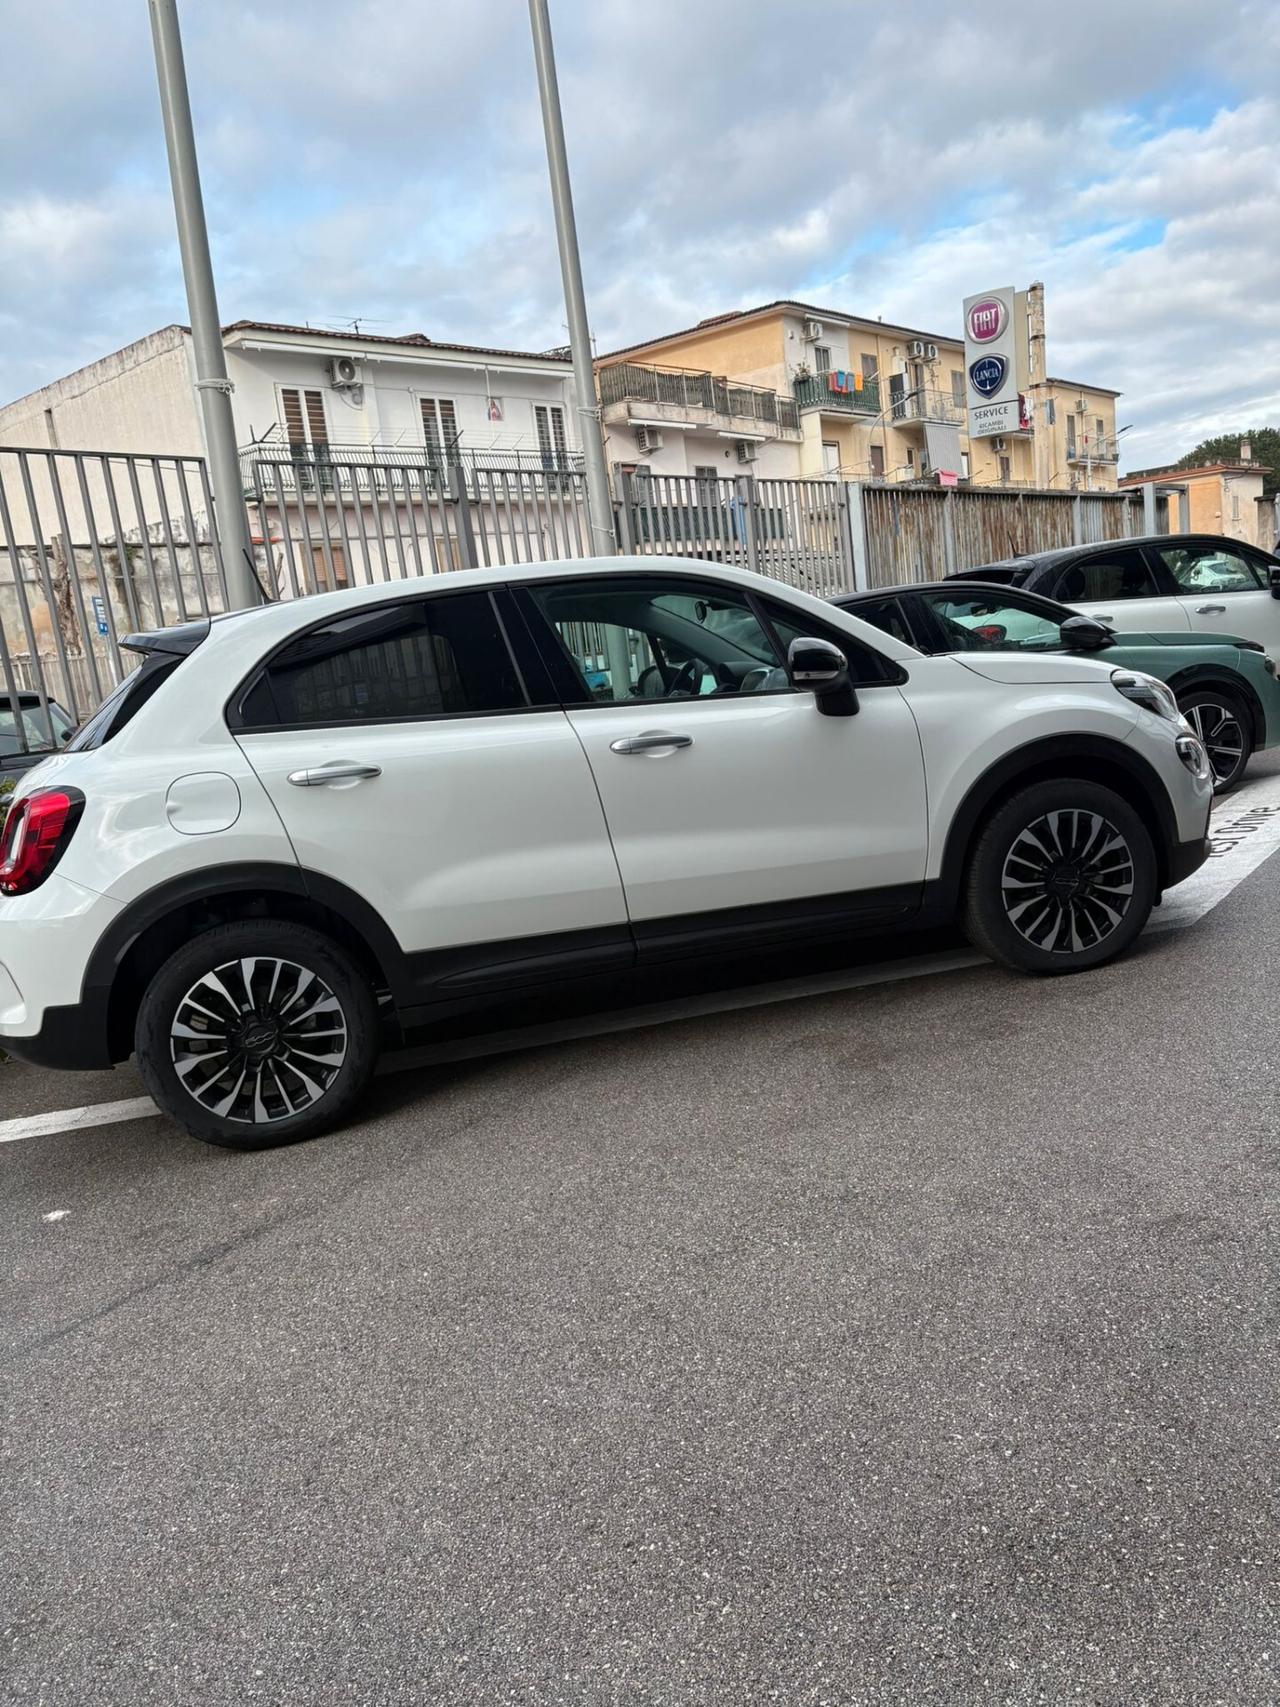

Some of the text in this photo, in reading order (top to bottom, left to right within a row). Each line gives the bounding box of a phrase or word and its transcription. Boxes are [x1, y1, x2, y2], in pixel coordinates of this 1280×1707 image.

[973, 308, 998, 333] FIAT
[975, 367, 999, 382] LANCIA
[974, 406, 1009, 421] SERVICE
[979, 419, 1004, 429] RICAMBI
